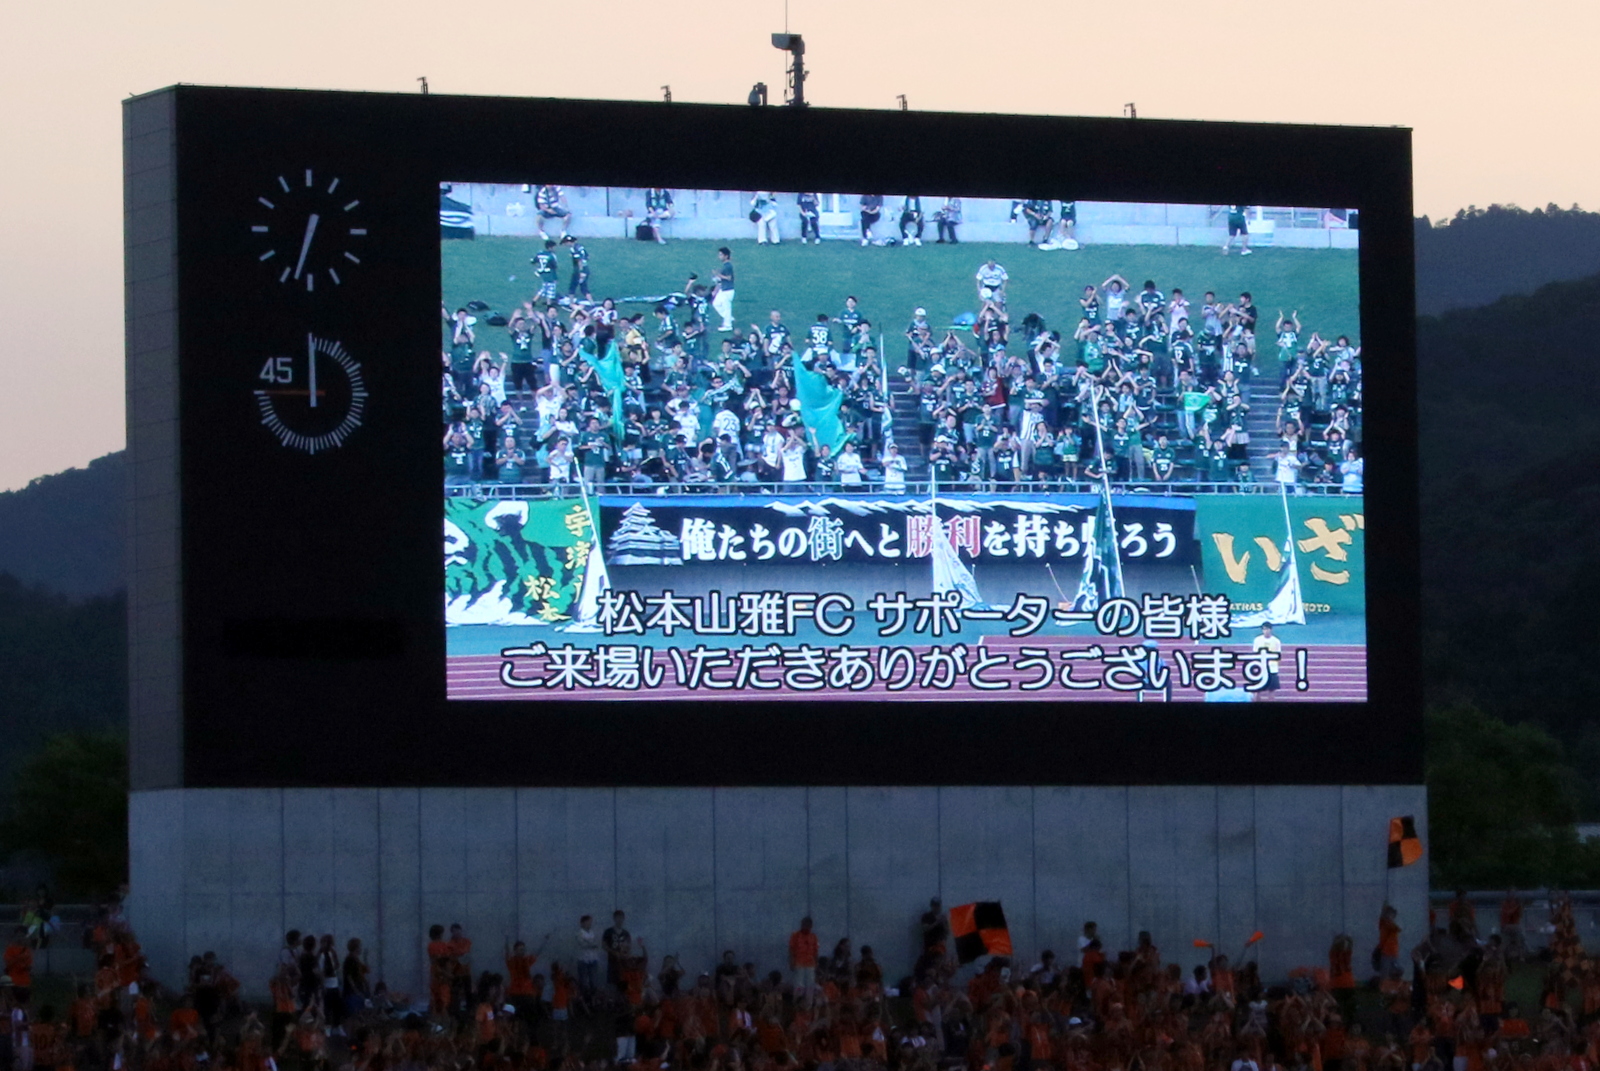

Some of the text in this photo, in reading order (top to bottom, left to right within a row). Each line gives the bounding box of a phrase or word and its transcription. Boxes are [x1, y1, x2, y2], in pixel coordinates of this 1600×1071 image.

[259, 357, 293, 384] 45
[681, 516, 1177, 561] 俺たちの街へと勝利を持ちろう
[598, 590, 1230, 639] 松本山雅FC サポーターの皆様
